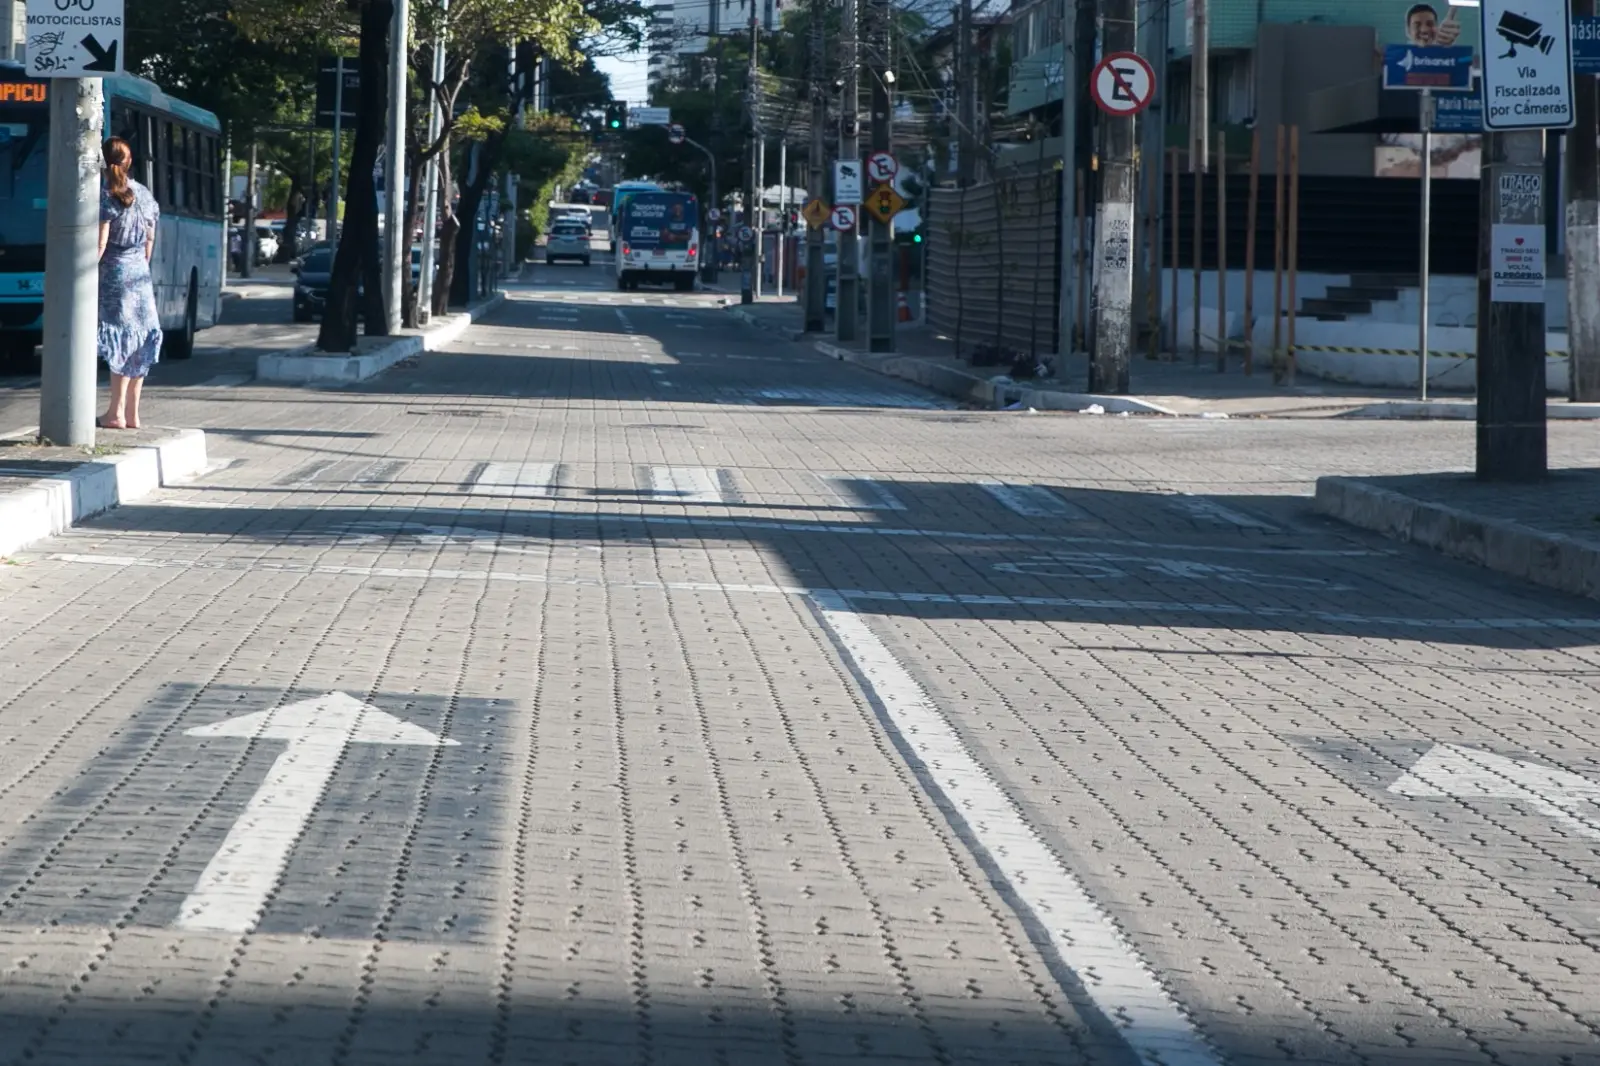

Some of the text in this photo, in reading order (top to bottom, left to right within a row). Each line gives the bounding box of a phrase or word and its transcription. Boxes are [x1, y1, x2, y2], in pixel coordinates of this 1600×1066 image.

[27, 15, 121, 26] MOTOCICLISTAS
[1414, 56, 1456, 67] brisanet
[1517, 66, 1537, 79] Via
[1112, 67, 1135, 101] E
[1495, 85, 1561, 98] Fiscalizada
[1490, 105, 1511, 119] por
[1513, 100, 1568, 115] Câmeras
[1503, 175, 1540, 190] TRAGO
